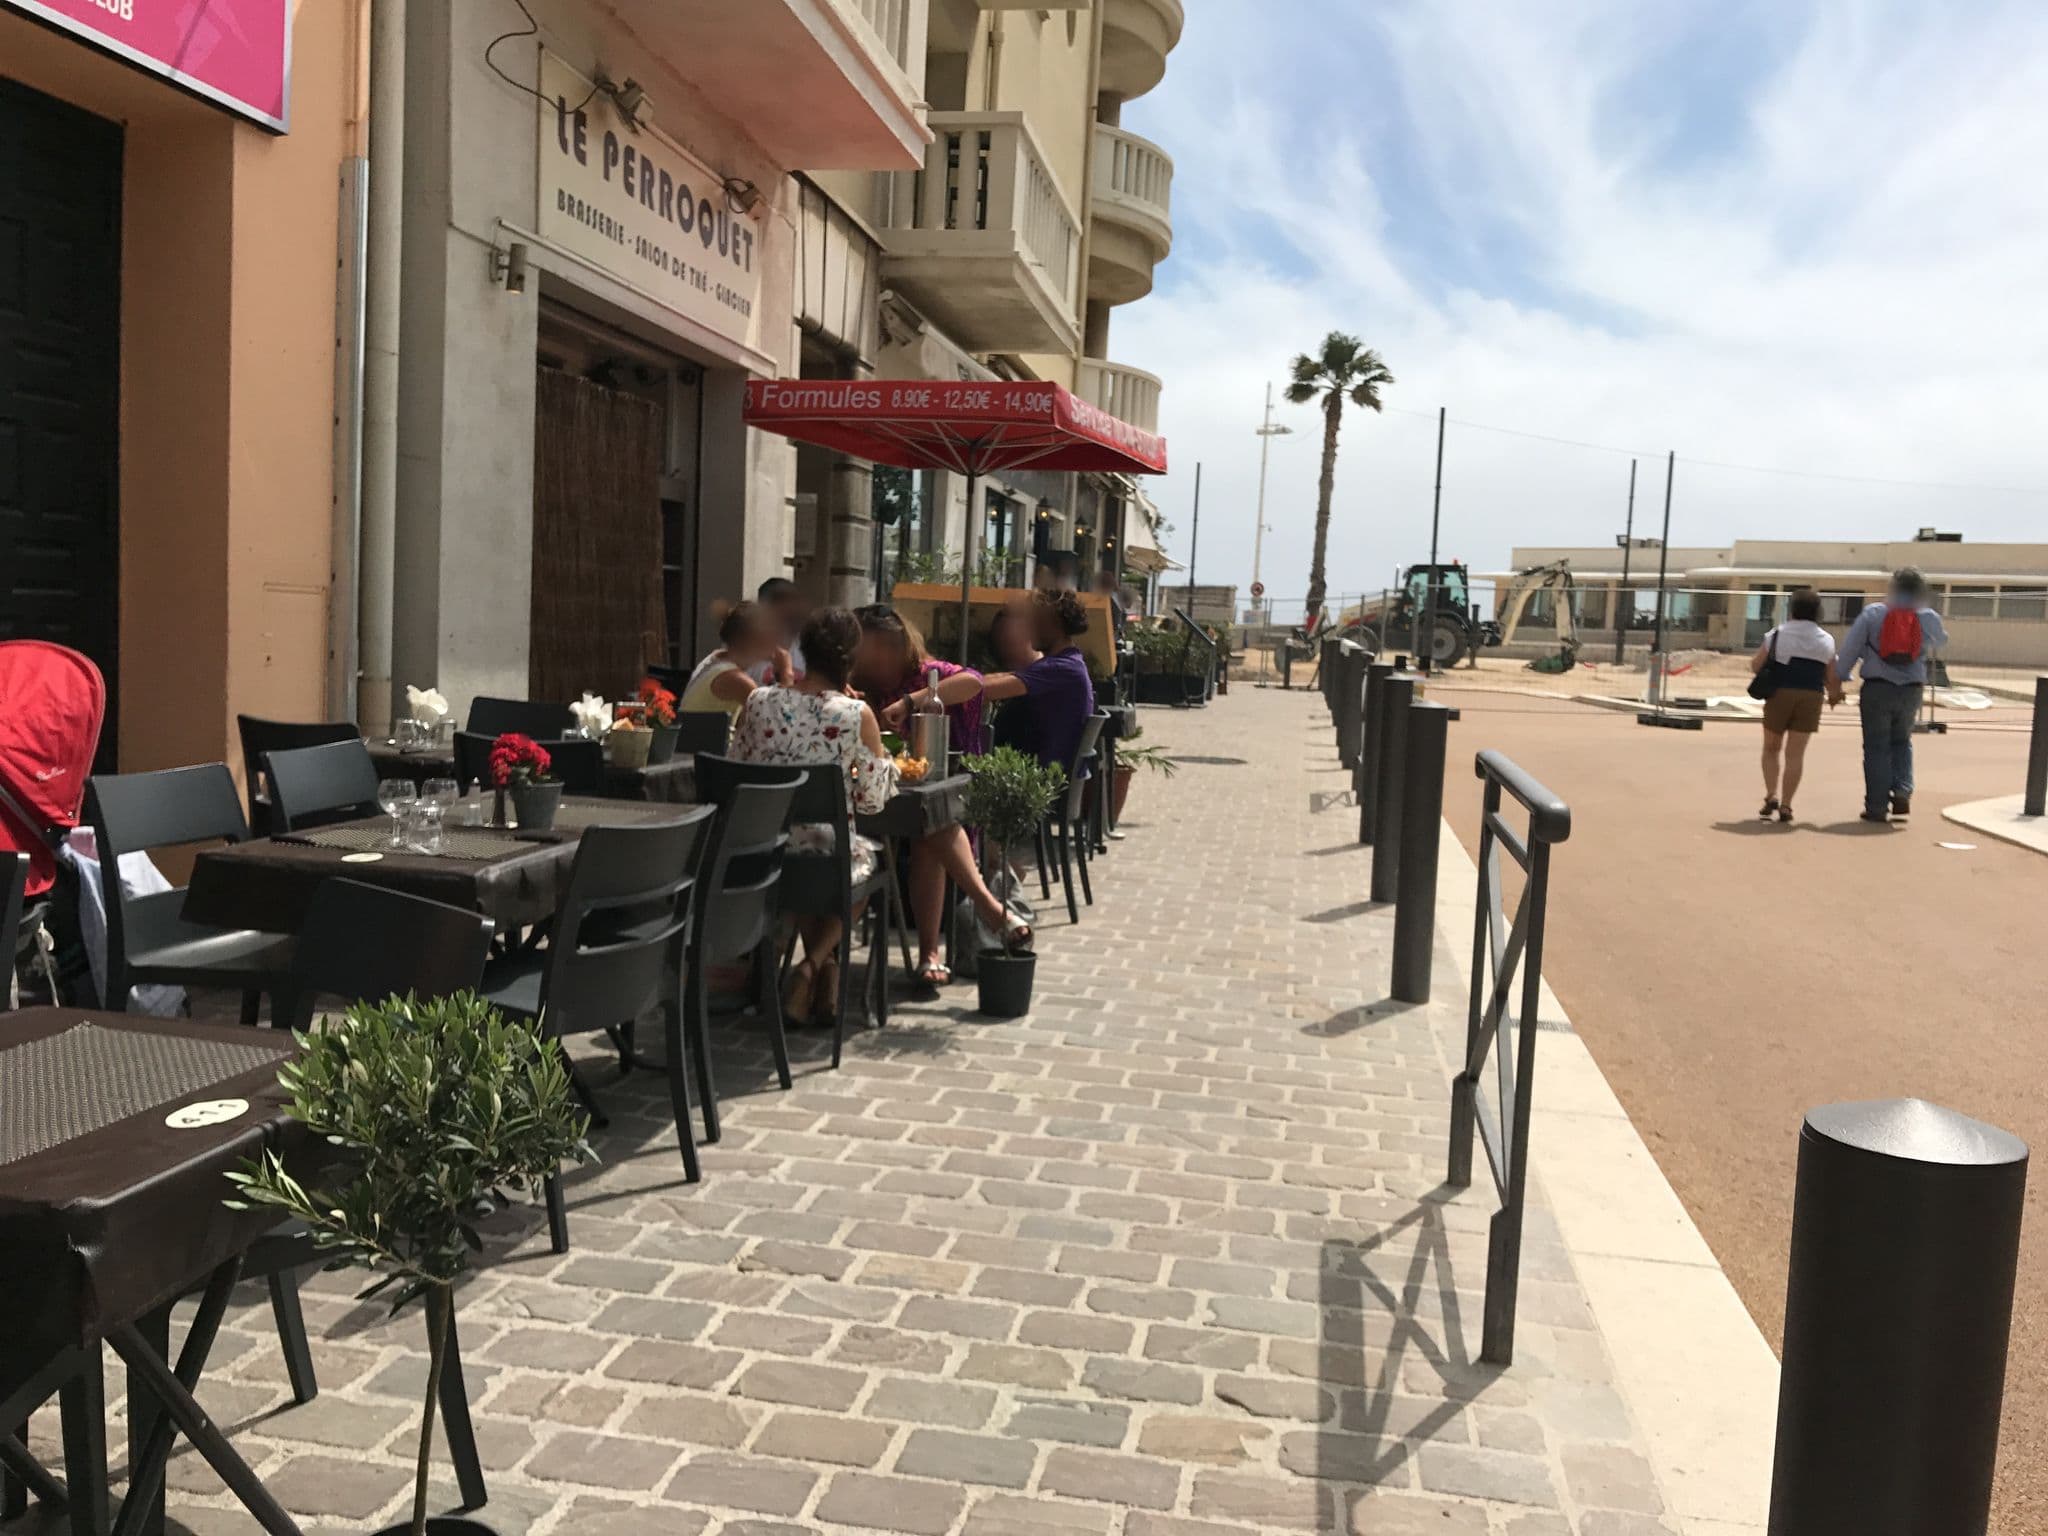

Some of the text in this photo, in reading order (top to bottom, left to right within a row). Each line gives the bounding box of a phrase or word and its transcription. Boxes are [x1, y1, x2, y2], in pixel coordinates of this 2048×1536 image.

[88, 0, 133, 21] UB
[558, 95, 753, 273] LE PERROQUET
[557, 188, 624, 246] BRASSERIE
[635, 235, 669, 272] SALON
[671, 257, 687, 281] DE
[689, 266, 708, 293] THÉ
[761, 384, 882, 409] Formules
[943, 390, 992, 411] 12,50€
[1004, 391, 1053, 414] 14,90€
